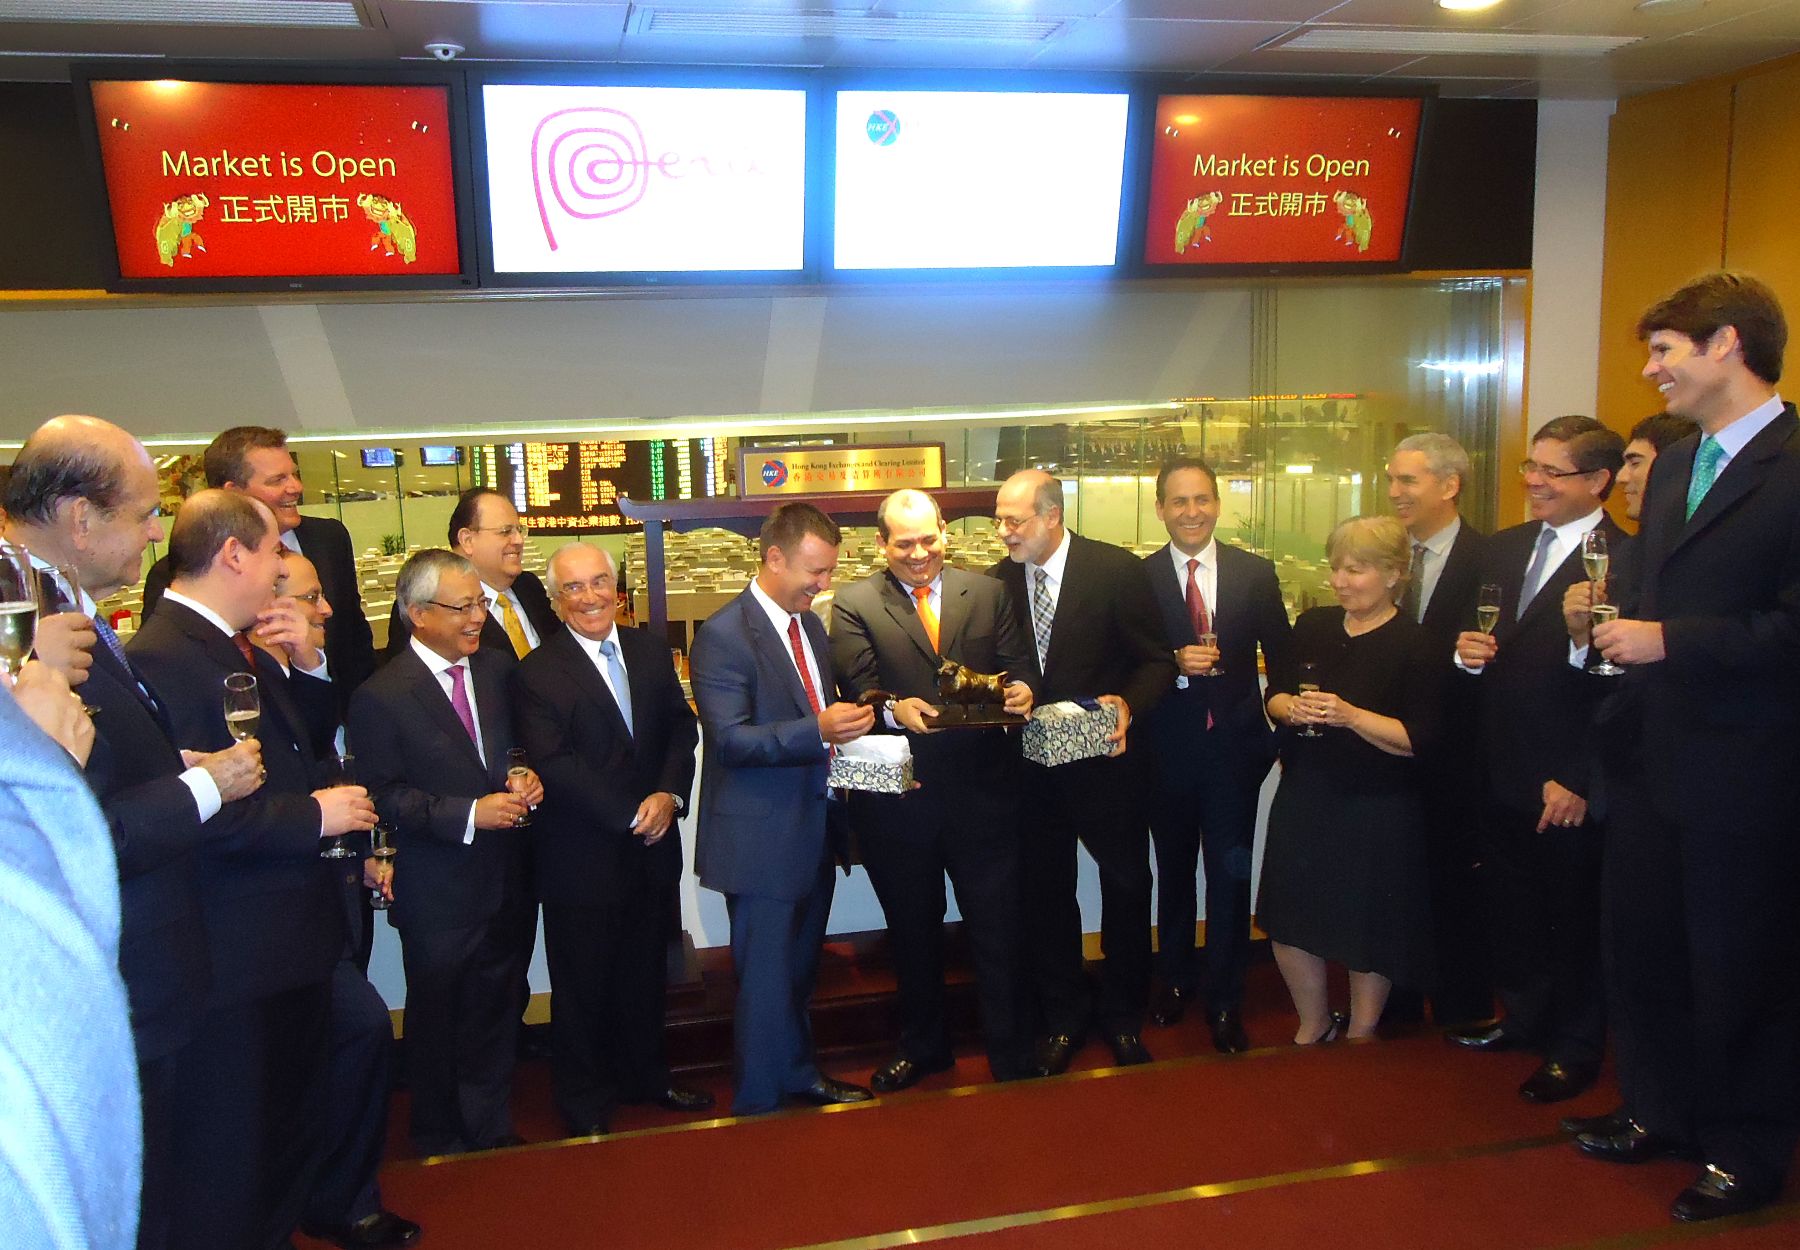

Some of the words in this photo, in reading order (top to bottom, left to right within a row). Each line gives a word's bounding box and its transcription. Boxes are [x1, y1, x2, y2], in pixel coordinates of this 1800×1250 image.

[161, 150, 272, 177] Market
[281, 151, 303, 177] is
[311, 150, 396, 184] Open
[1193, 153, 1277, 177] Market
[1283, 154, 1300, 177] is
[1306, 153, 1370, 183] Open
[219, 194, 350, 224] 正式開市
[1227, 191, 1329, 217] 正式開市
[792, 463, 809, 471] Hong
[811, 462, 828, 471] Kong
